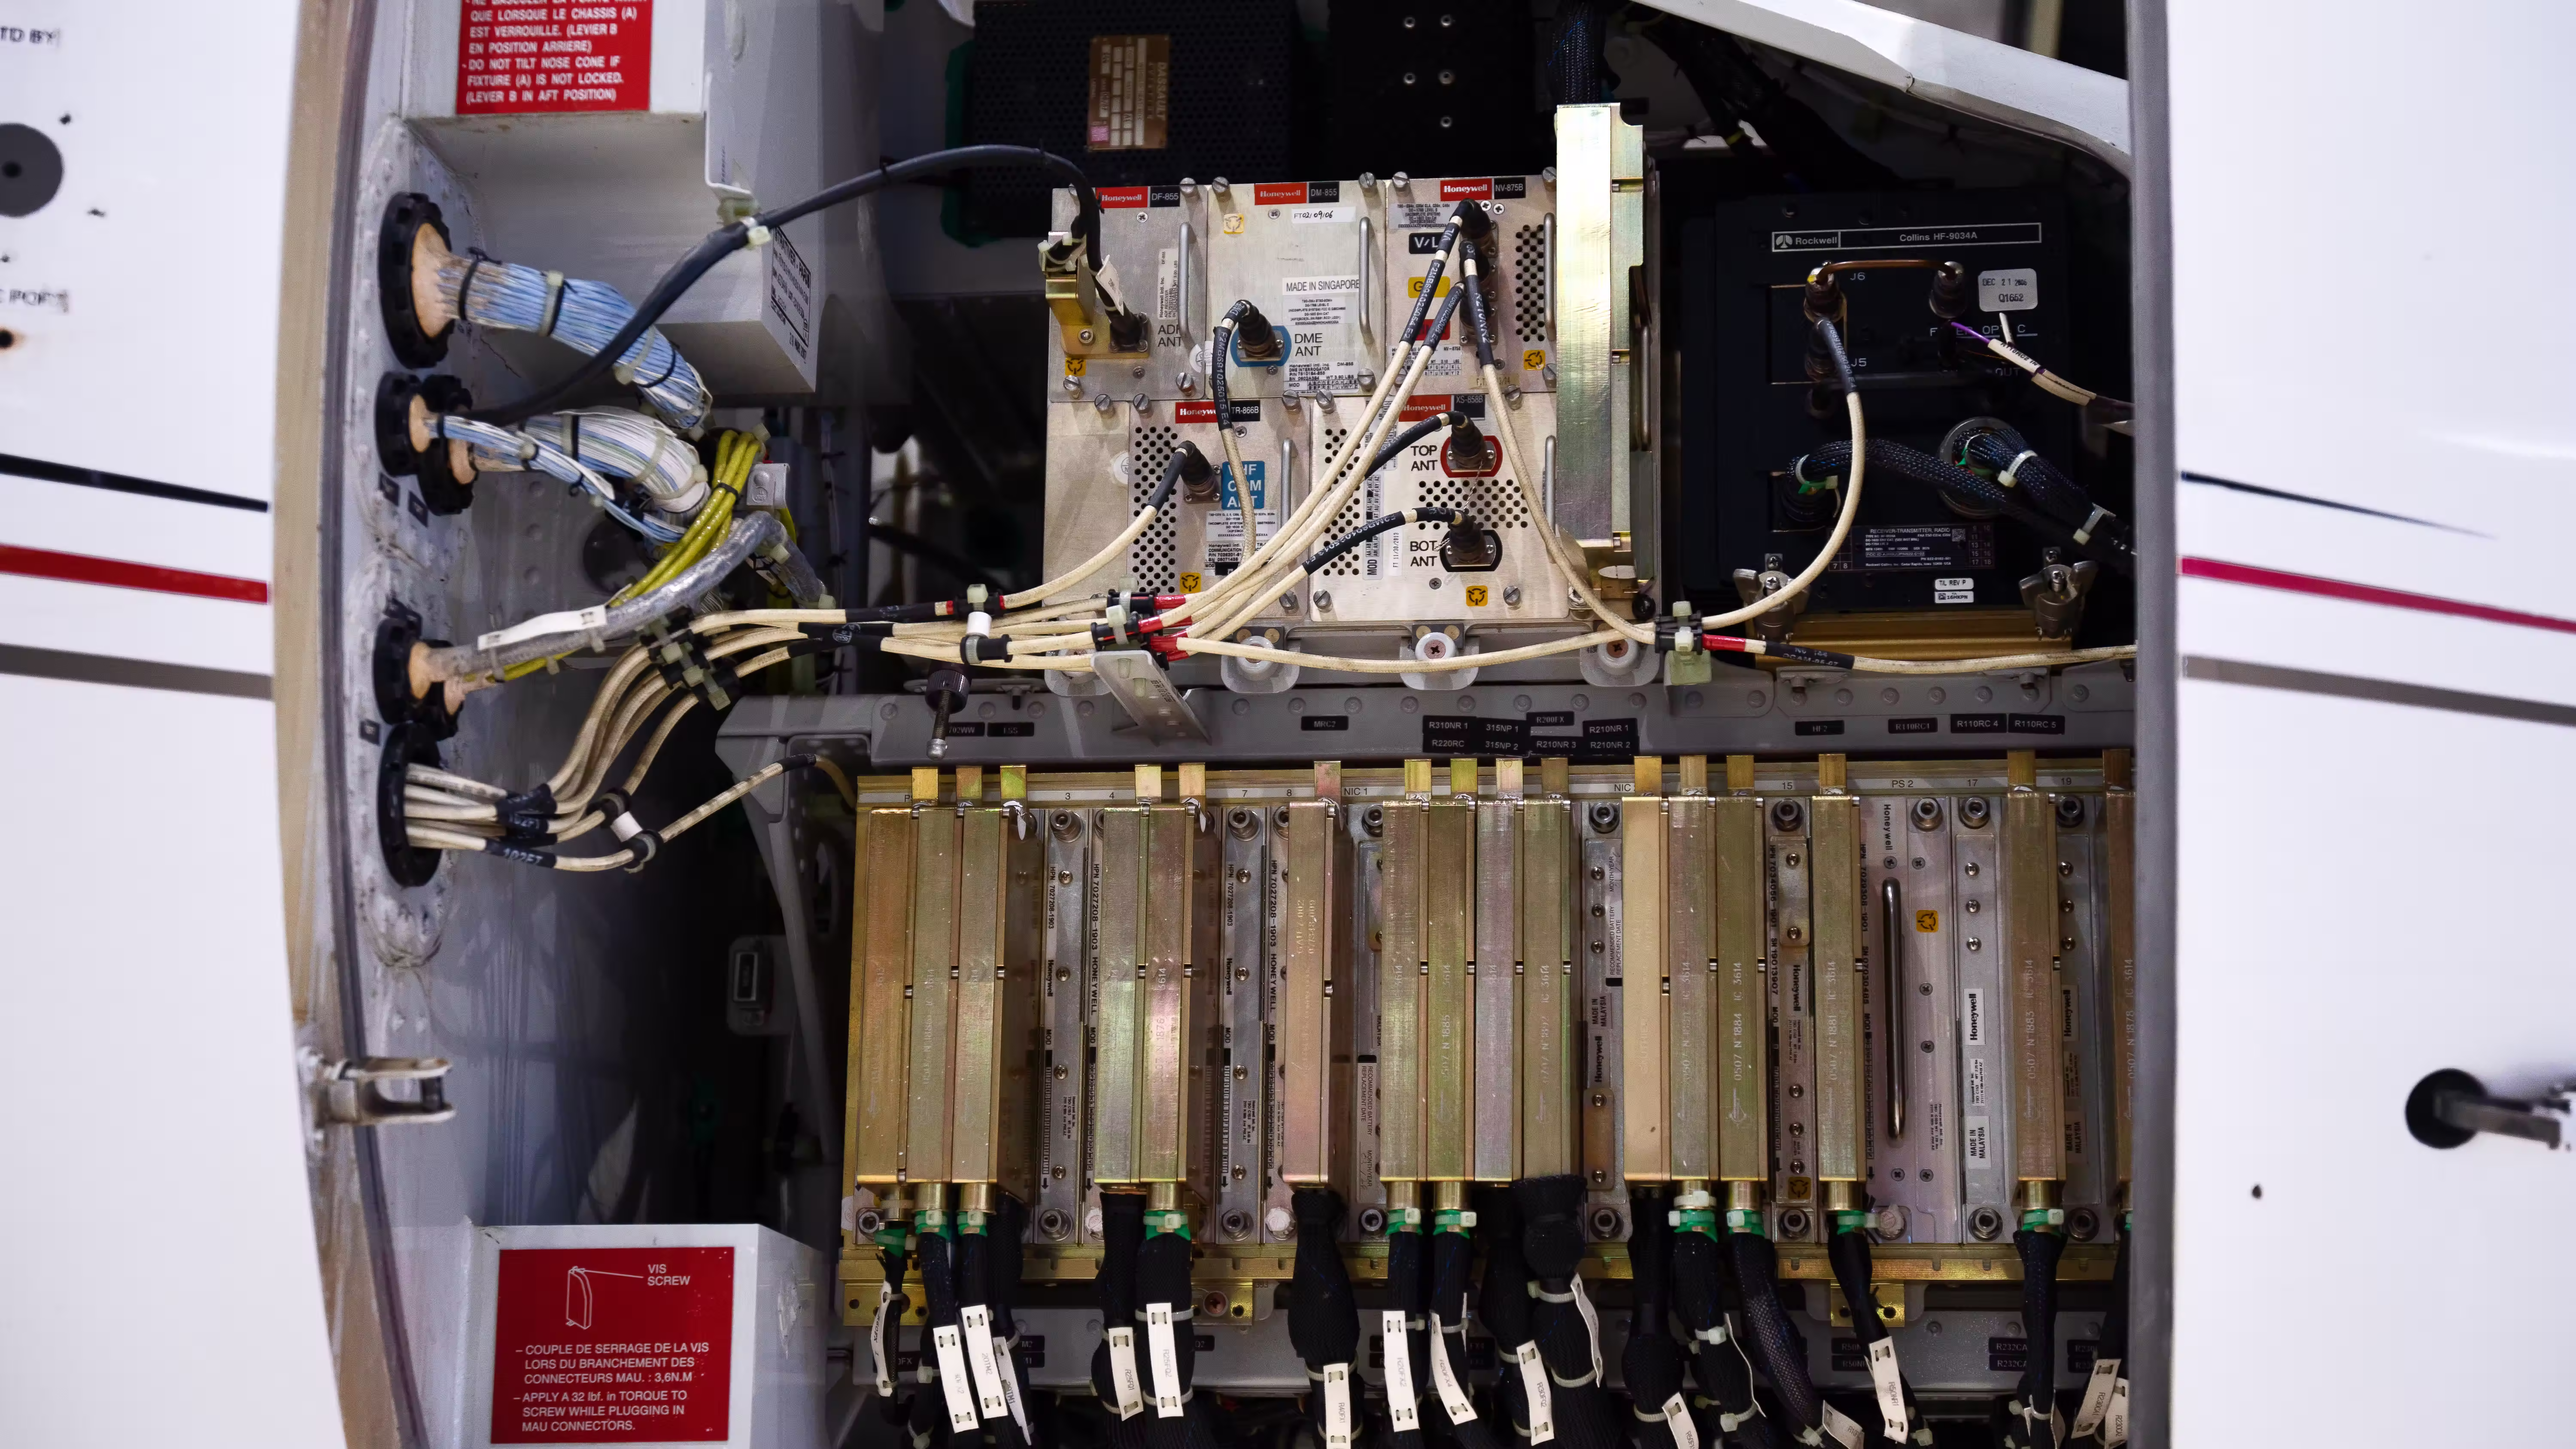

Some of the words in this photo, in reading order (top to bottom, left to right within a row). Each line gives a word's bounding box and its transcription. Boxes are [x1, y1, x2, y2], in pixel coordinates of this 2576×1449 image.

[471, 10, 492, 21] QUE
[498, 9, 547, 21] LORSQUE
[553, 8, 566, 20] LE
[571, 7, 617, 19] CHASSIS
[621, 6, 637, 21] (A)
[470, 26, 490, 38] EST
[495, 24, 562, 37] VERROUILLE.
[566, 24, 607, 38] (LEVIER
[609, 24, 617, 35] B
[469, 42, 483, 54] EN
[489, 41, 537, 53] POSITION
[543, 40, 592, 54] ARRIERE)
[468, 58, 484, 70] DO
[489, 58, 510, 70] NOT
[516, 58, 536, 69] TILT
[541, 57, 571, 69] NOSE
[575, 56, 605, 68] CONE
[610, 55, 620, 67] IF
[467, 74, 511, 87] FIXTURE
[516, 73, 532, 88] (A)
[536, 73, 546, 85] IS
[551, 73, 573, 85] NOT
[578, 72, 623, 84] LOCKED.
[466, 91, 504, 105] (LEVER
[509, 91, 517, 103] B
[522, 90, 533, 102] IN
[538, 89, 559, 101] AFT
[563, 88, 617, 103] POSITION)
[1444, 184, 1487, 193] Honeywell
[1495, 183, 1523, 191] NV-875B
[1260, 190, 1301, 198] Honeywell
[1795, 236, 1838, 246] Rockwell
[1900, 232, 1930, 242] Collins
[1933, 231, 1978, 241] HF-9034A
[1850, 273, 1865, 281] J6
[1982, 278, 1996, 286] DEC
[1286, 282, 1307, 291] MADE
[1309, 281, 1316, 291] IN
[1318, 279, 1360, 290] SINGAPORE
[1999, 293, 2024, 303] Q1652
[1157, 336, 1182, 347] ANT
[1295, 333, 1323, 344] DME
[1295, 346, 1321, 356] ANT
[1851, 358, 1866, 367] J5
[1456, 395, 1483, 403] XS-858B
[1231, 406, 1259, 414] TR-866B
[1410, 445, 1437, 456] TOP
[1411, 460, 1438, 471] ANT
[1410, 540, 1437, 552] BOT
[1410, 556, 1437, 567] ANT
[1367, 559, 1377, 576] MOD
[1486, 724, 1512, 732] 315NP
[1589, 725, 1622, 734] R210NR
[1485, 741, 1511, 749] 315NP
[1892, 780, 1905, 788] PS
[1883, 804, 1892, 850] Honeywell
[1791, 964, 1801, 1012] Honeywell
[1592, 998, 1598, 1006] IN
[1970, 994, 1978, 1040] Honeywell
[1595, 1035, 1604, 1083] Honeywell
[648, 1264, 667, 1273] VIS
[647, 1276, 690, 1286] SCREW
[526, 1345, 573, 1355] COUPLE
[576, 1344, 592, 1355] DE
[595, 1344, 651, 1354] SERRAGE
[654, 1343, 670, 1353] DE
[674, 1343, 687, 1353] LA
[690, 1342, 709, 1352] VIS
[525, 1360, 556, 1370] LORS
[560, 1359, 576, 1369] DU
[579, 1358, 668, 1368] BRANCHEMENT
[671, 1357, 694, 1367] DES
[1162, 1349, 1173, 1378] R25FQ2
[524, 1373, 613, 1385] CONNECTEURS
[617, 1373, 645, 1383] MAU.
[654, 1372, 693, 1384] 3,6N.M
[1124, 1369, 1133, 1391] R25FQ1
[522, 1392, 559, 1403] APPLY
[561, 1392, 569, 1402] A
[571, 1392, 584, 1401] 32
[587, 1391, 604, 1402] lbf.
[606, 1391, 616, 1401] in
[619, 1391, 668, 1402] TORQUE
[671, 1390, 687, 1400] TO
[1536, 1382, 1547, 1408] R30FQ2
[1889, 1382, 1899, 1407] R50NR1
[522, 1407, 565, 1417] SCREW
[568, 1406, 605, 1416] WHILE
[608, 1406, 669, 1416] PLUGGING
[673, 1405, 684, 1415] IN
[522, 1422, 547, 1432] MAU
[551, 1420, 635, 1431] CONNECTORS.
